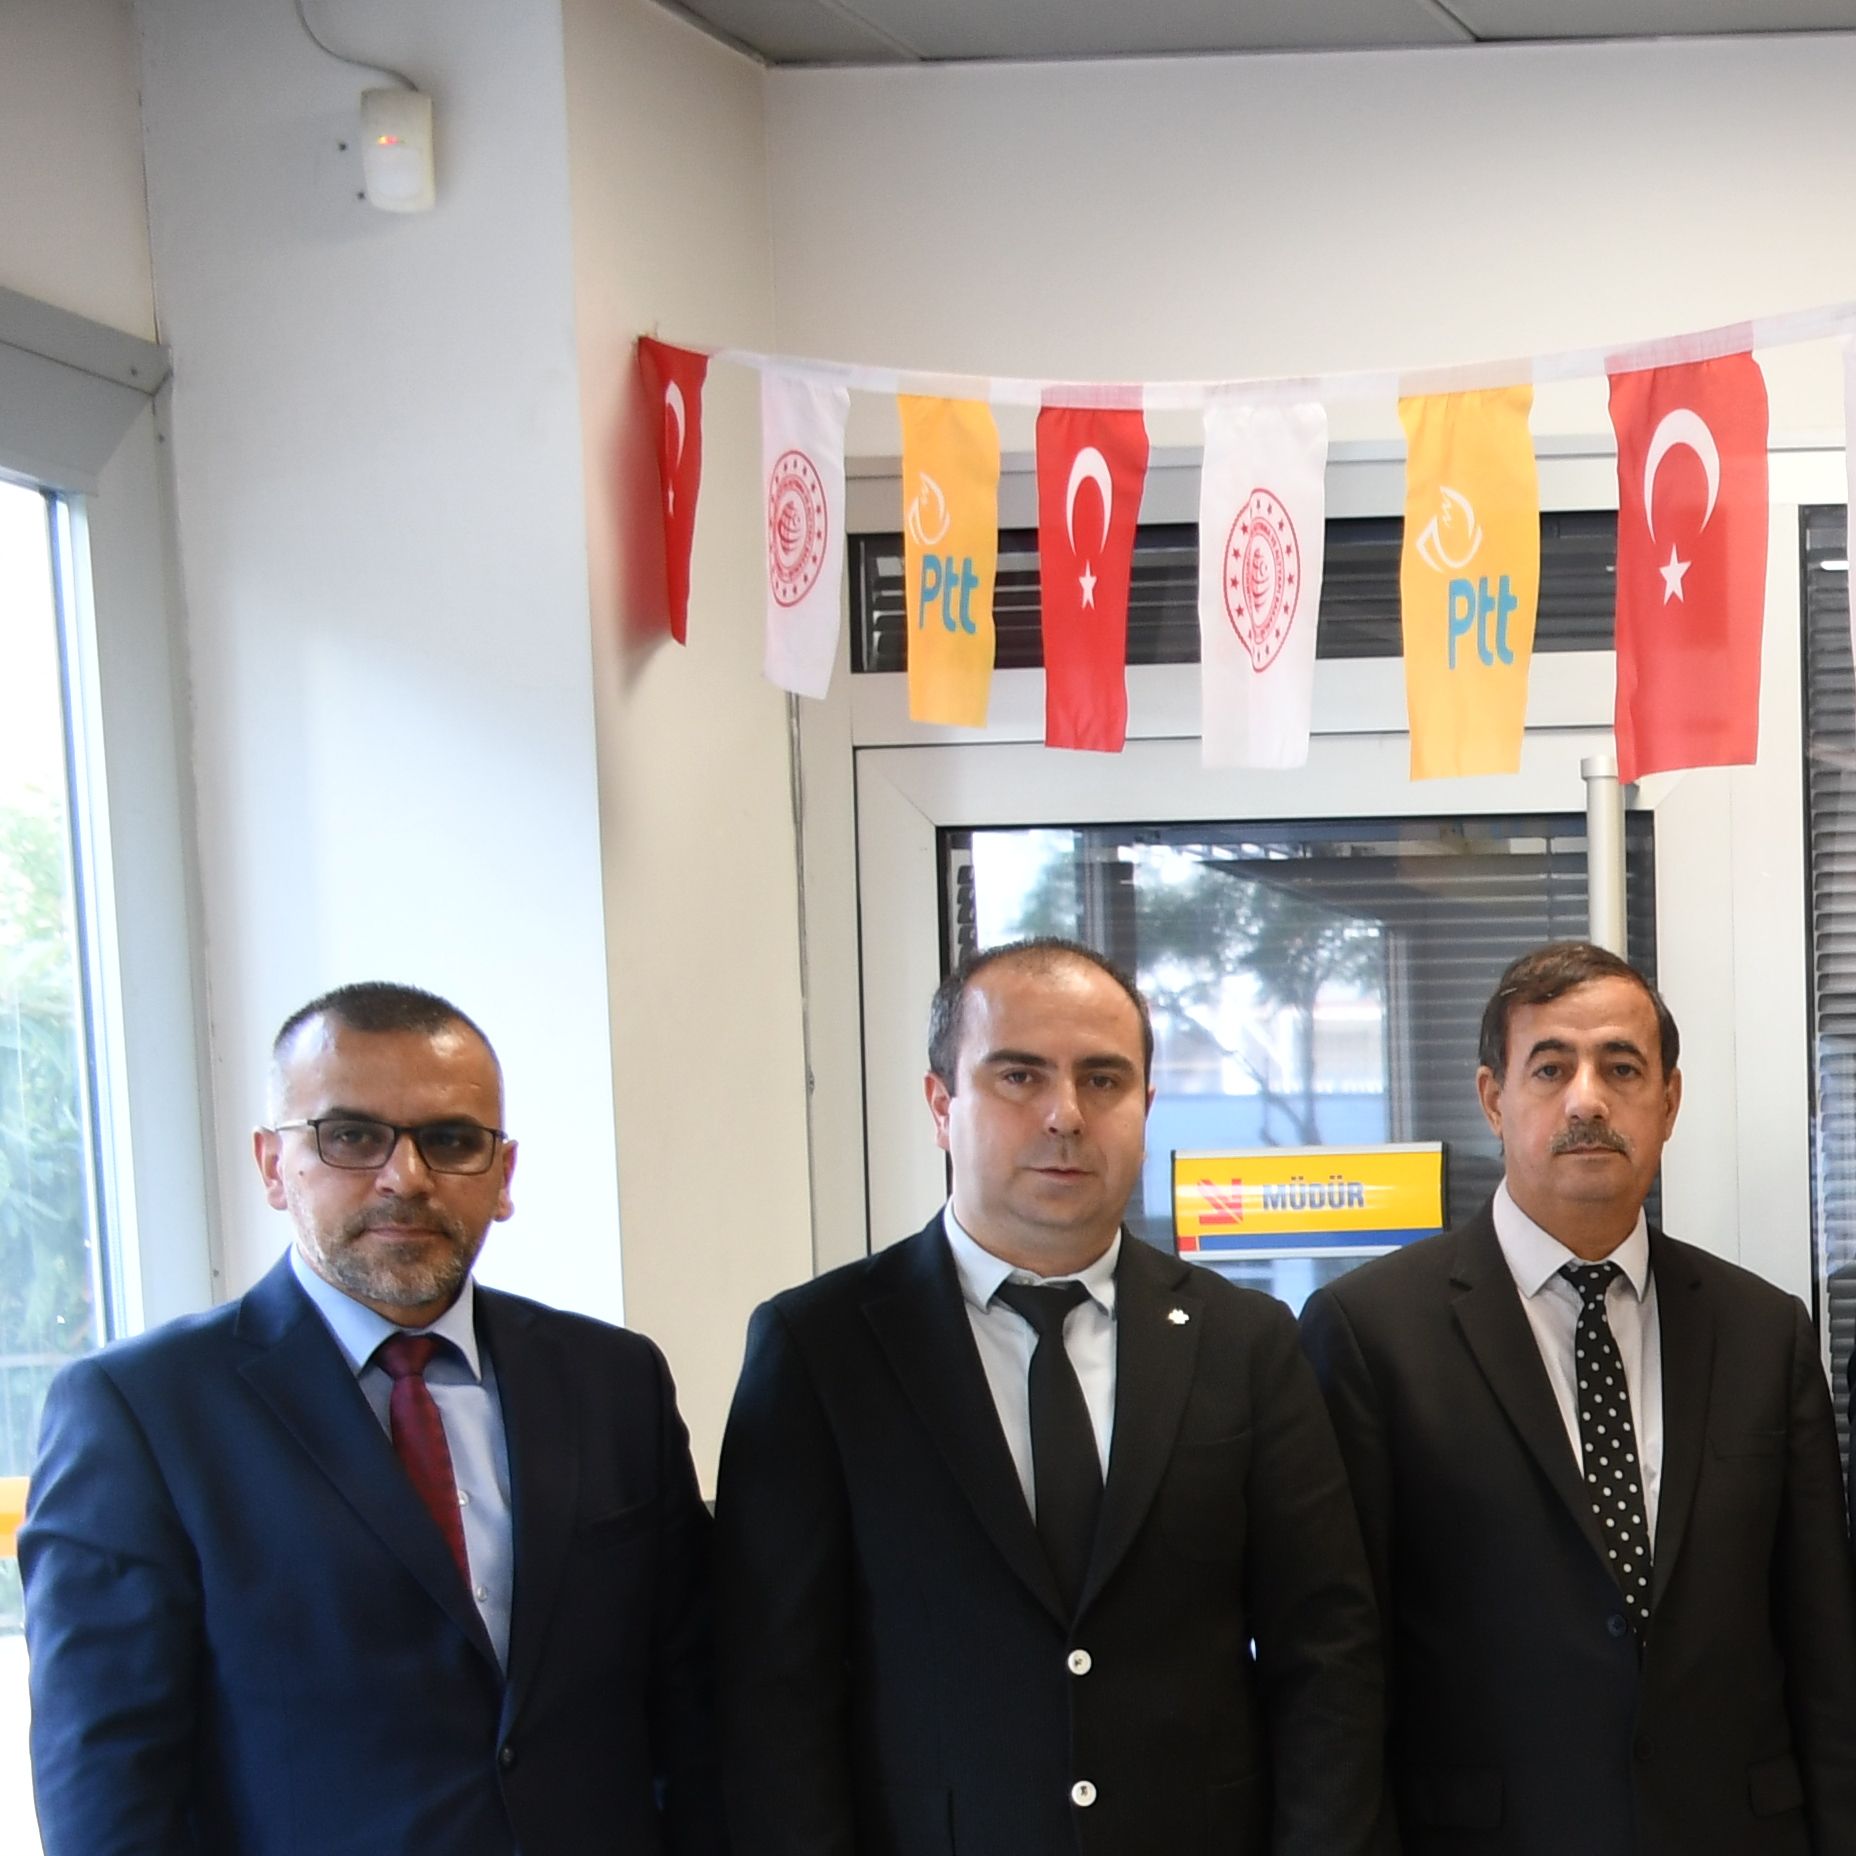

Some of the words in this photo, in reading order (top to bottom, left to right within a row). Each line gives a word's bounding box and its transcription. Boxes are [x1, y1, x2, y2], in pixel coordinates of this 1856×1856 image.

[918, 554, 979, 635] Ptt
[1448, 575, 1518, 671] Ptt
[1262, 1174, 1365, 1211] MÜDÜR
